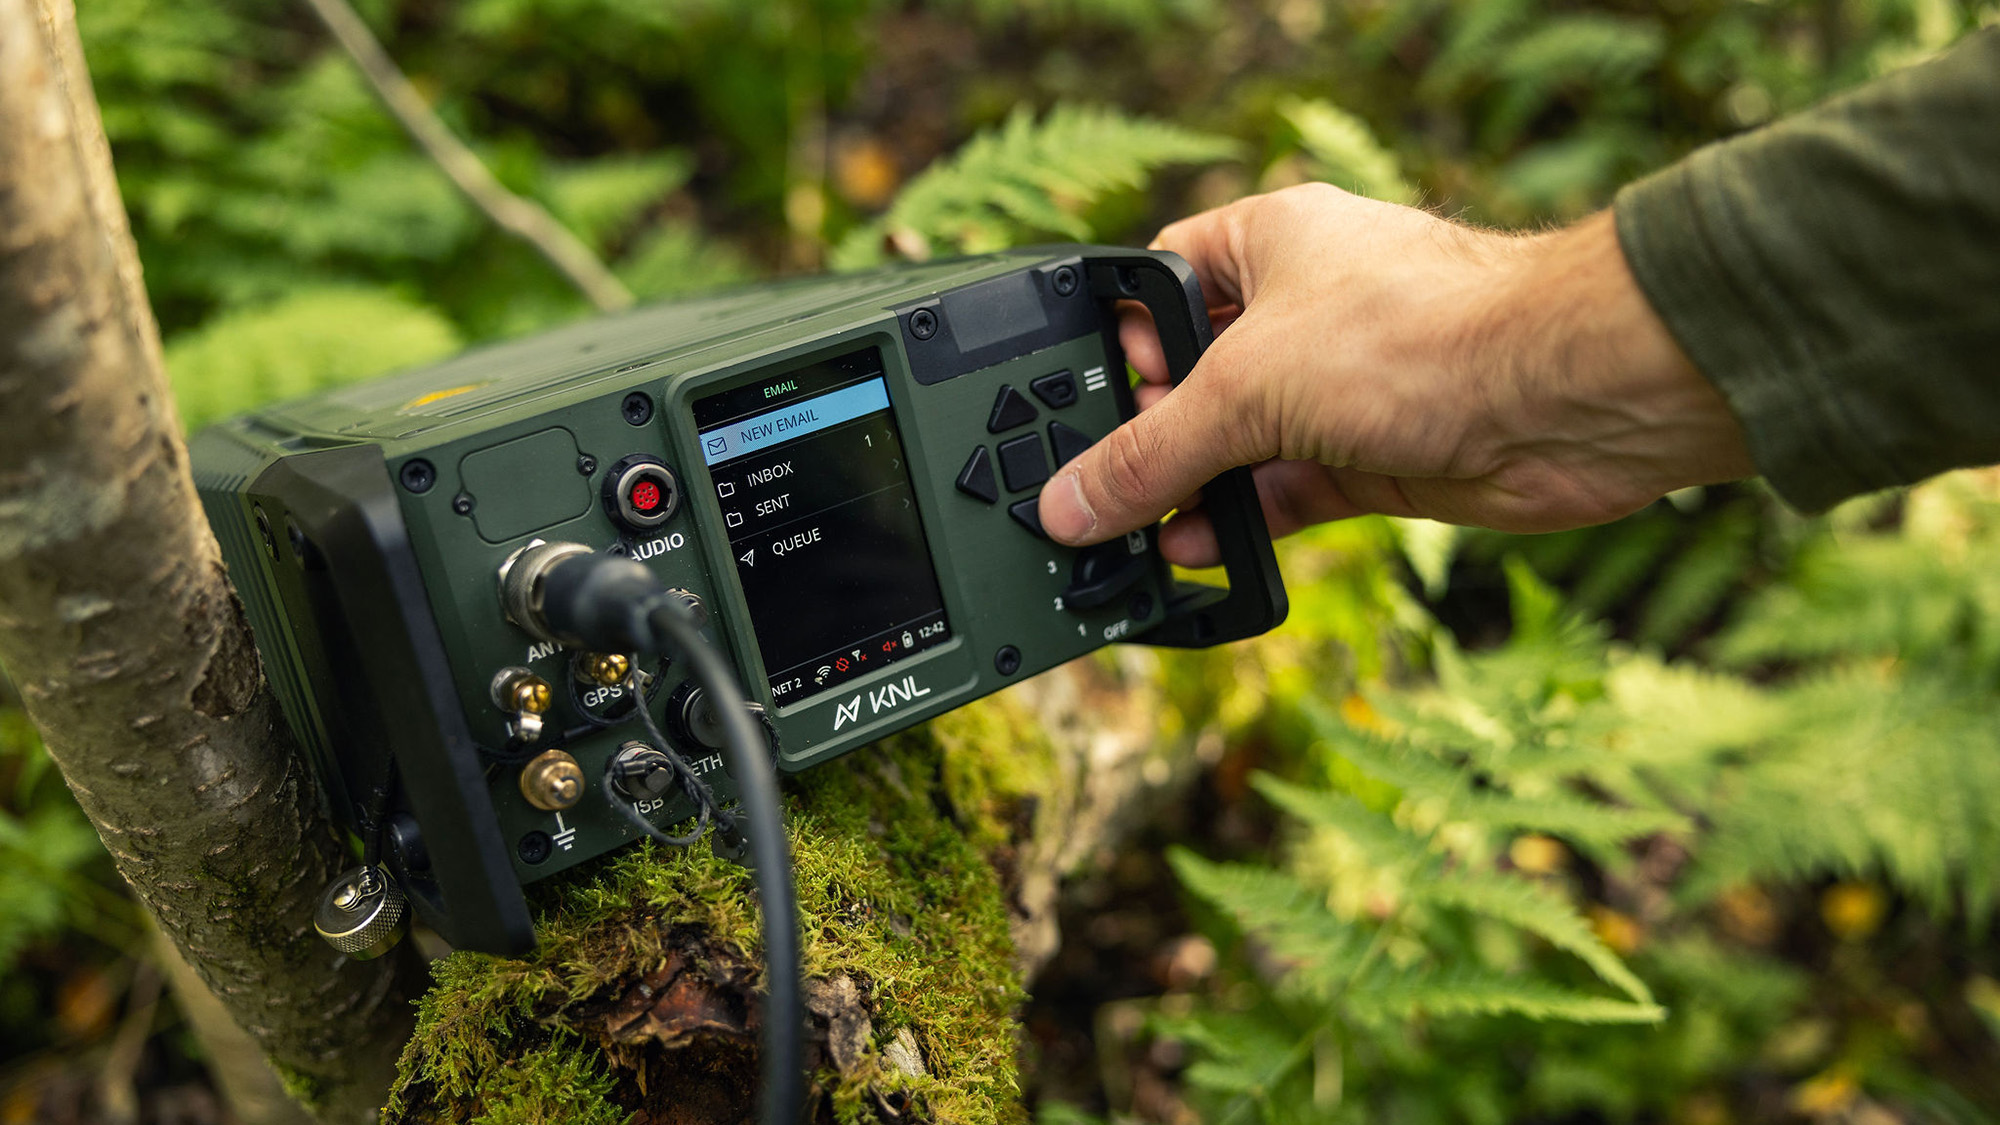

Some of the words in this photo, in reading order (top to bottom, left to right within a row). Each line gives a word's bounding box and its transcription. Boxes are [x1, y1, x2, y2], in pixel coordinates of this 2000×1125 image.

[763, 380, 798, 399] EMAIL
[740, 422, 773, 444] NEW
[776, 409, 819, 432] EMAIL
[747, 461, 794, 487] INBOX
[865, 434, 872, 448] 1
[755, 494, 790, 517] SENT
[631, 533, 684, 561] AUDIO
[772, 528, 822, 556] QUEUE
[1047, 560, 1057, 574] 3
[1054, 597, 1064, 611] 2
[918, 621, 945, 639] 12:42
[1077, 623, 1087, 637] 1
[1104, 619, 1130, 640] OFF
[583, 684, 623, 708] GPS
[771, 681, 792, 697] NET
[794, 677, 803, 688] 2
[868, 676, 931, 714] KNL
[691, 753, 724, 777] ETH
